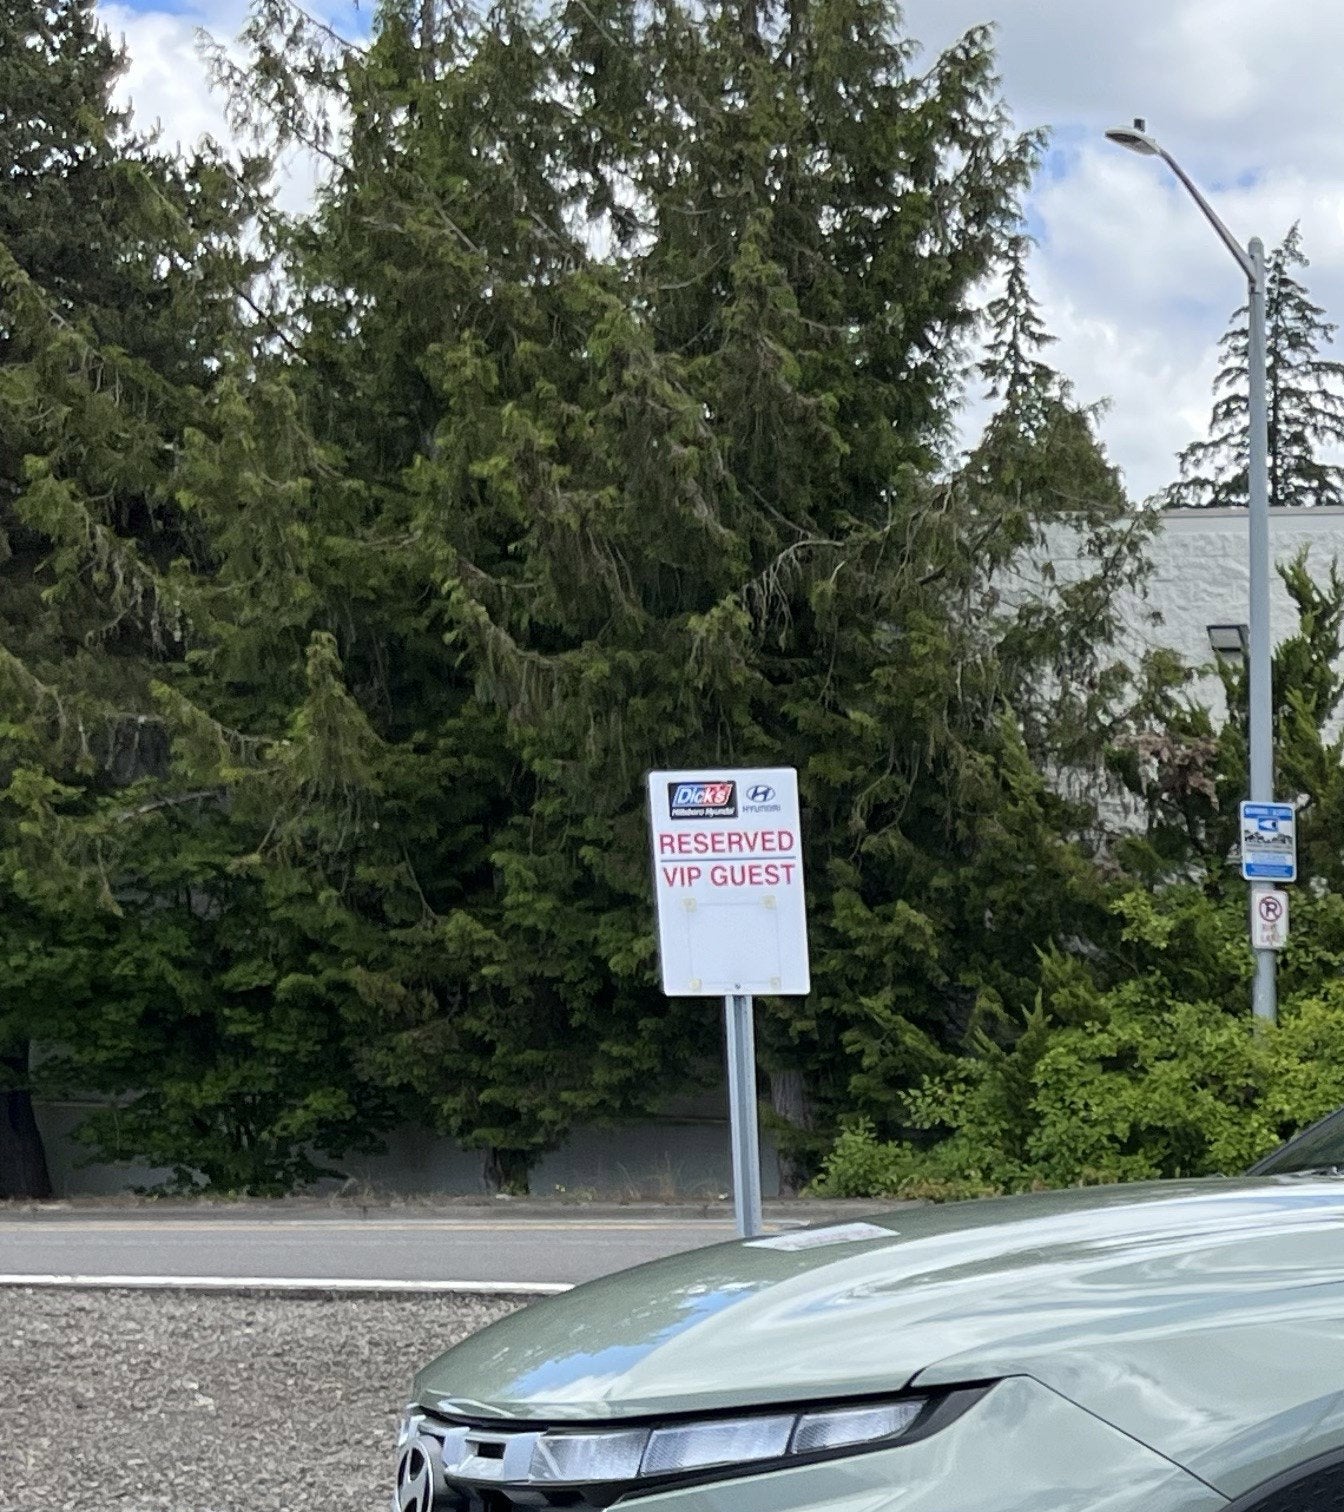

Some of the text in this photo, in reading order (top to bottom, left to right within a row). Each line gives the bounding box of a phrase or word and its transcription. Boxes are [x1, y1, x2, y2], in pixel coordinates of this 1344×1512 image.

[659, 831, 795, 854] RESERVED
[663, 864, 796, 887] VIP GUEST
